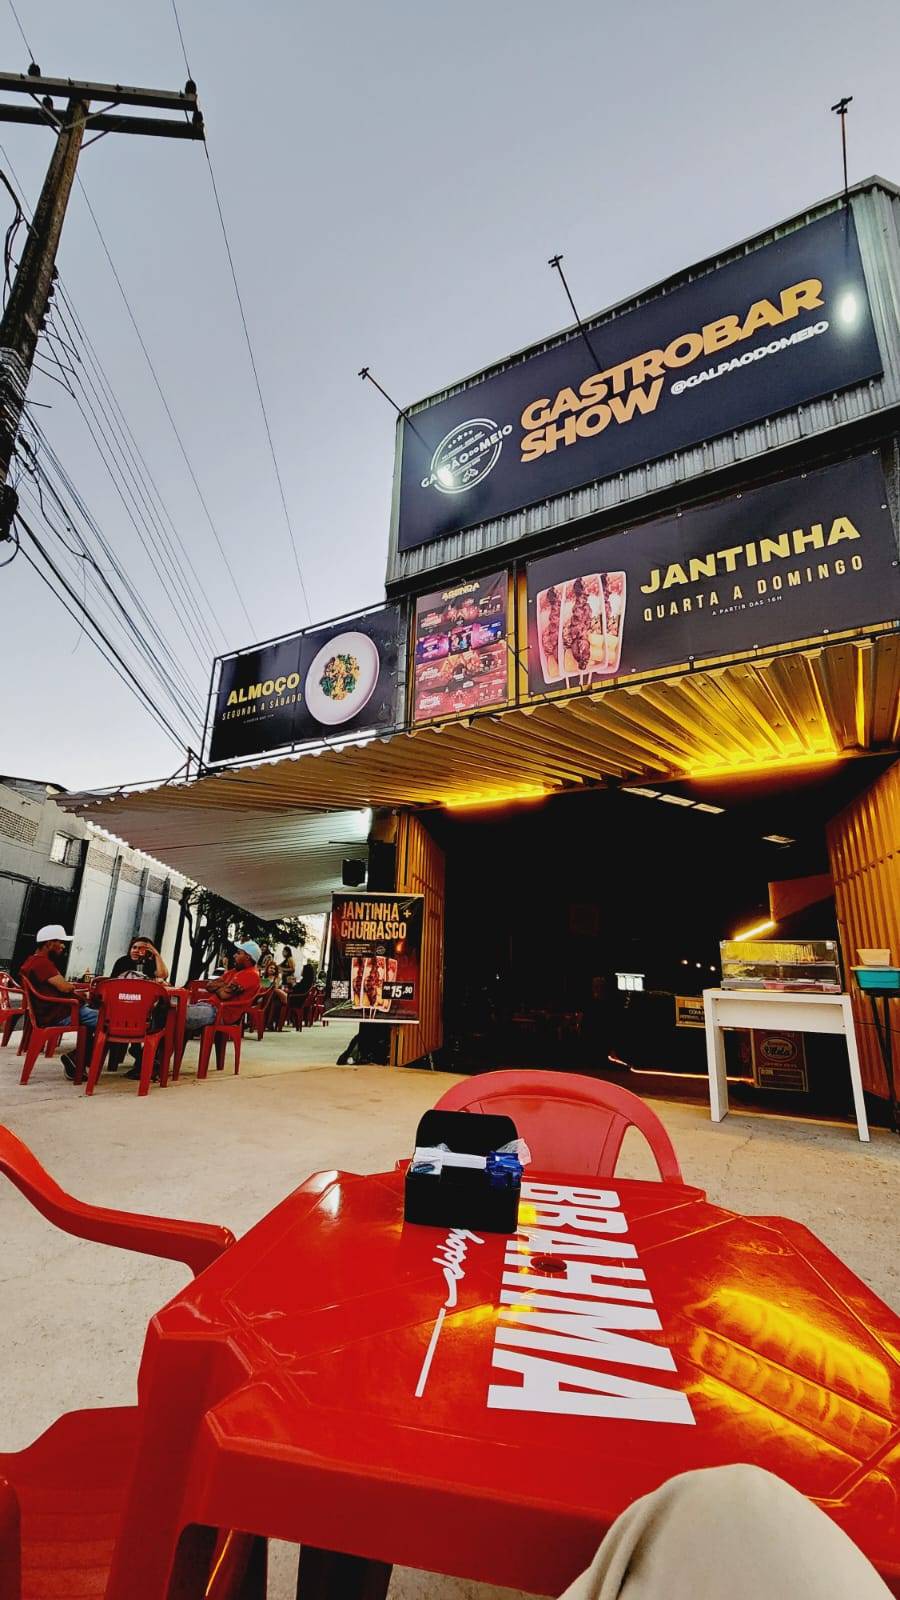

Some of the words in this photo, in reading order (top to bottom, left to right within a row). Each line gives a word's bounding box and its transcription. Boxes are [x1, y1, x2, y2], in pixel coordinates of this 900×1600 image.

[520, 278, 825, 430] GASTROBAR
[670, 320, 829, 395] @GALPAODOMEIO
[520, 376, 665, 463] SHOW
[421, 452, 469, 488] GAPÃO
[479, 424, 513, 452] MEIO
[640, 516, 861, 594] JANTINHA
[643, 591, 719, 622] QUARTA
[733, 585, 743, 600] A
[757, 555, 864, 595] DOMINGO
[719, 604, 746, 614] PARTIR
[749, 600, 764, 608] DAS
[222, 704, 257, 721] SEGUNDA
[260, 702, 265, 711] A
[226, 672, 300, 706] ALMOÇO
[341, 920, 407, 940] CHURRASCO
[342, 901, 399, 921] JANTINHA
[118, 993, 141, 1001] BRAHMA
[487, 1181, 697, 1425] BRAHMA
